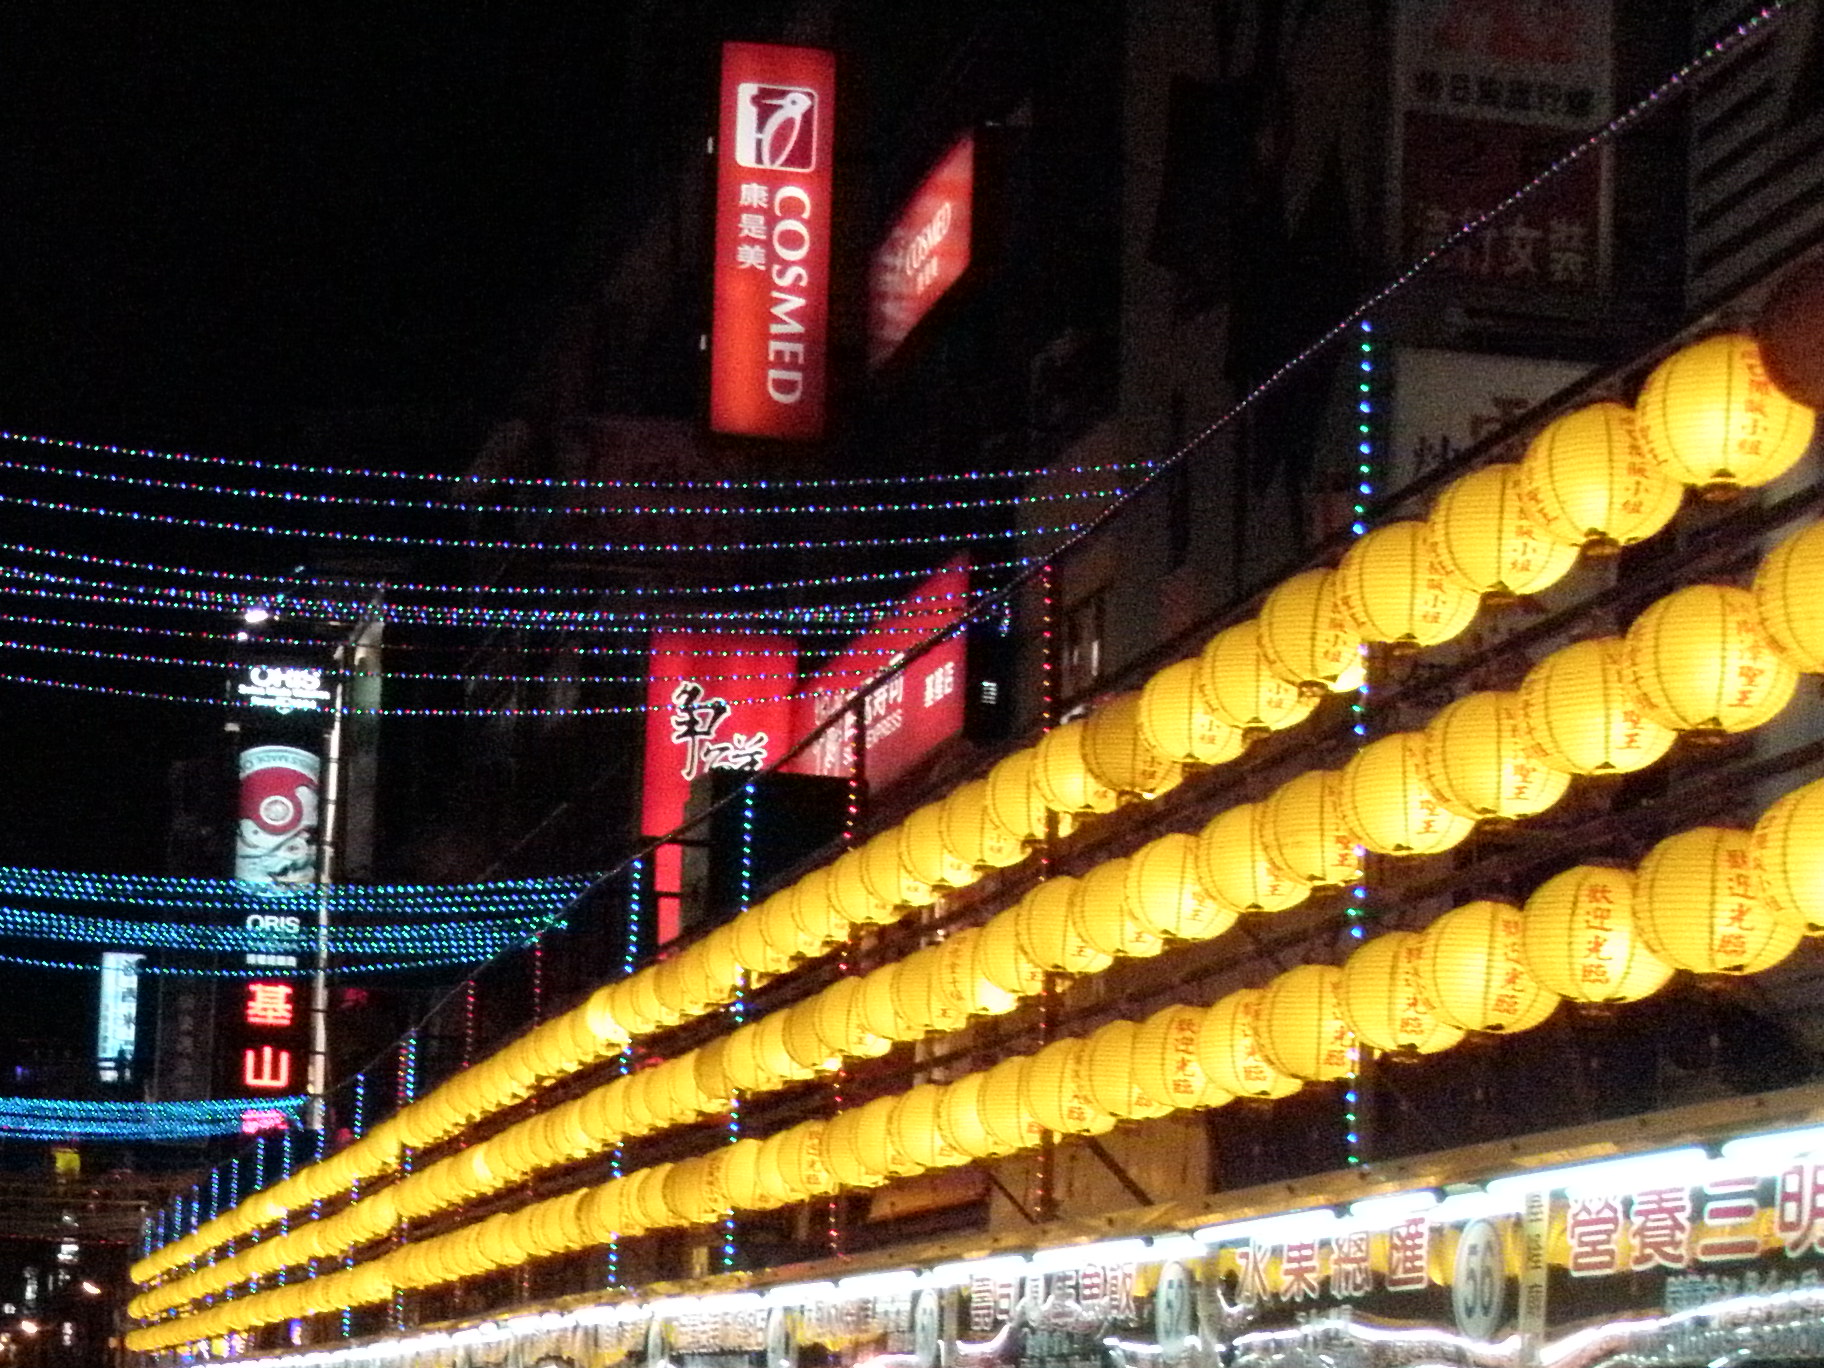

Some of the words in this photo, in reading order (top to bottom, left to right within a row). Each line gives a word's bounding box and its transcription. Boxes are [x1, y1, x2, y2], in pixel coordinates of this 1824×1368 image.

[735, 181, 769, 272] 康是美
[767, 184, 812, 405] COSMED
[245, 914, 301, 935] ORIS
